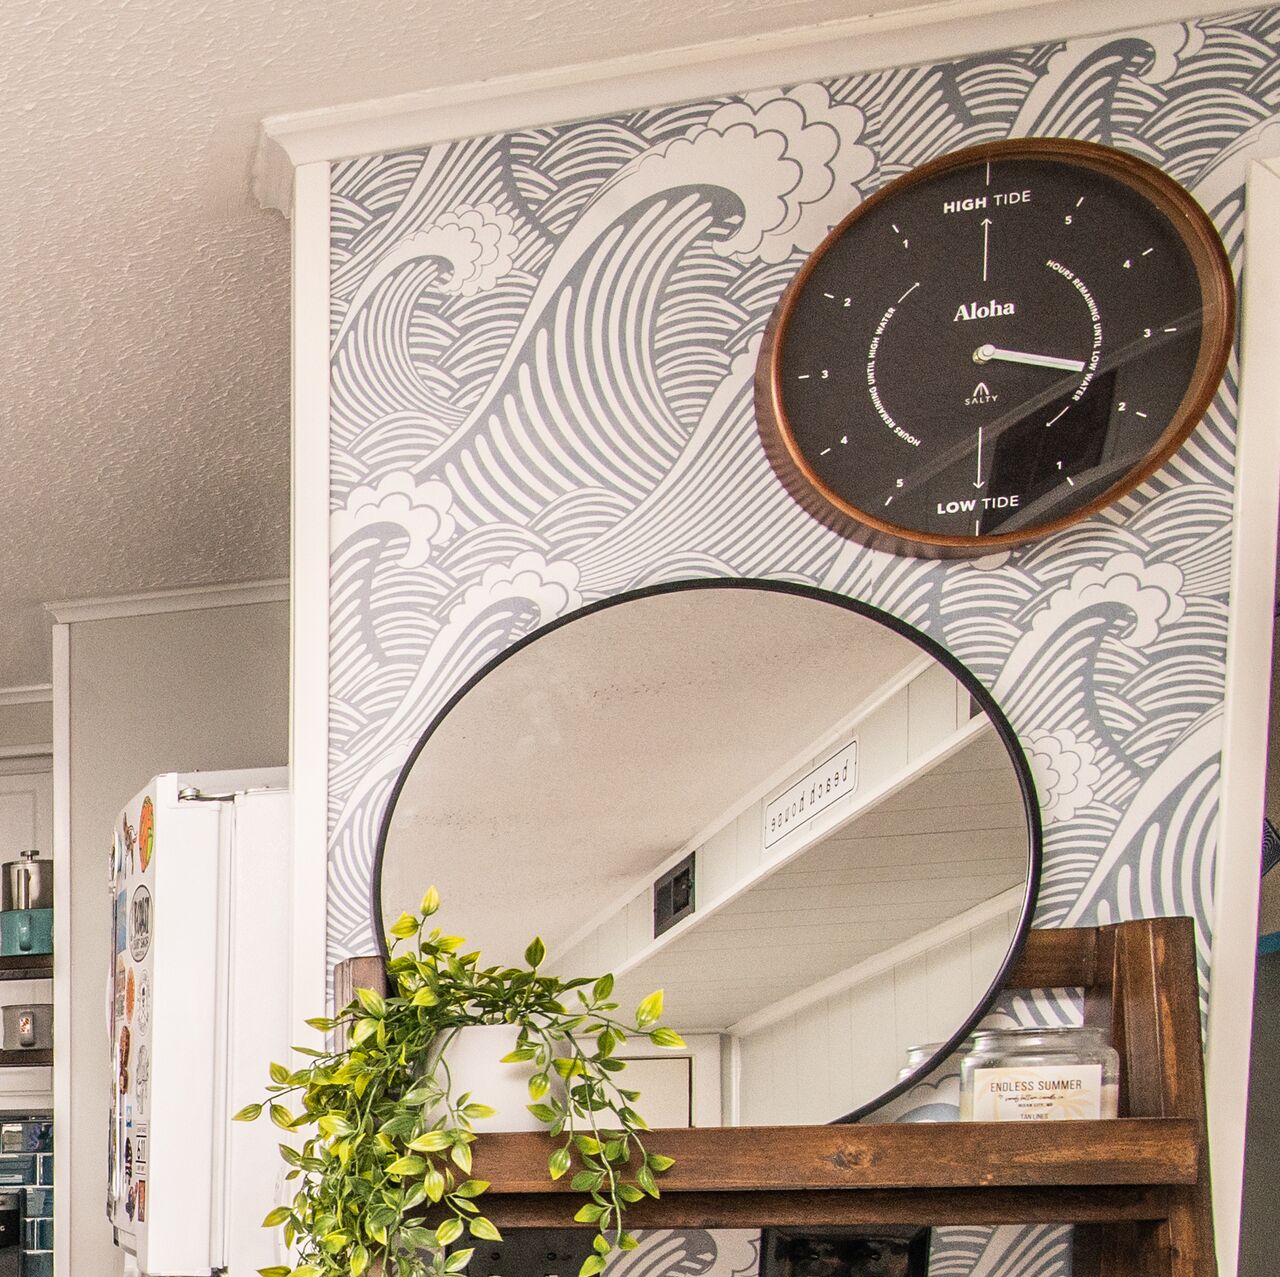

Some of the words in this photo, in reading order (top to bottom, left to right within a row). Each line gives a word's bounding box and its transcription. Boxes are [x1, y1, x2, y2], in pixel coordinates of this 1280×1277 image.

[943, 197, 987, 214] HIGH
[993, 190, 1032, 206] TIDE
[1064, 216, 1072, 225] 5
[902, 239, 909, 248] 1
[1046, 259, 1075, 280] HOURS
[1122, 260, 1131, 269] 4
[843, 297, 851, 307] 2
[1072, 278, 1101, 322] REMAINING
[875, 307, 896, 335] WATER
[953, 300, 1015, 322] Aloha
[1093, 323, 1103, 348] UNTIL
[1143, 328, 1151, 338] 3
[868, 337, 880, 359] HIGH
[1089, 351, 1101, 371] LOW
[821, 369, 829, 379] 3
[866, 360, 876, 385] UNTIL
[1072, 373, 1094, 402] WATER
[868, 386, 896, 429] REMAINING
[964, 395, 998, 406] SALTY
[1118, 402, 1126, 411] 2
[840, 435, 849, 445] 4
[894, 426, 921, 447] HOURS
[1055, 460, 1063, 470] 1
[896, 478, 903, 488] 5
[937, 500, 976, 515] LOW
[982, 495, 1019, 509] TIDE
[991, 1081, 1034, 1093] ENDLESS
[1038, 1079, 1082, 1091] SUMMER
